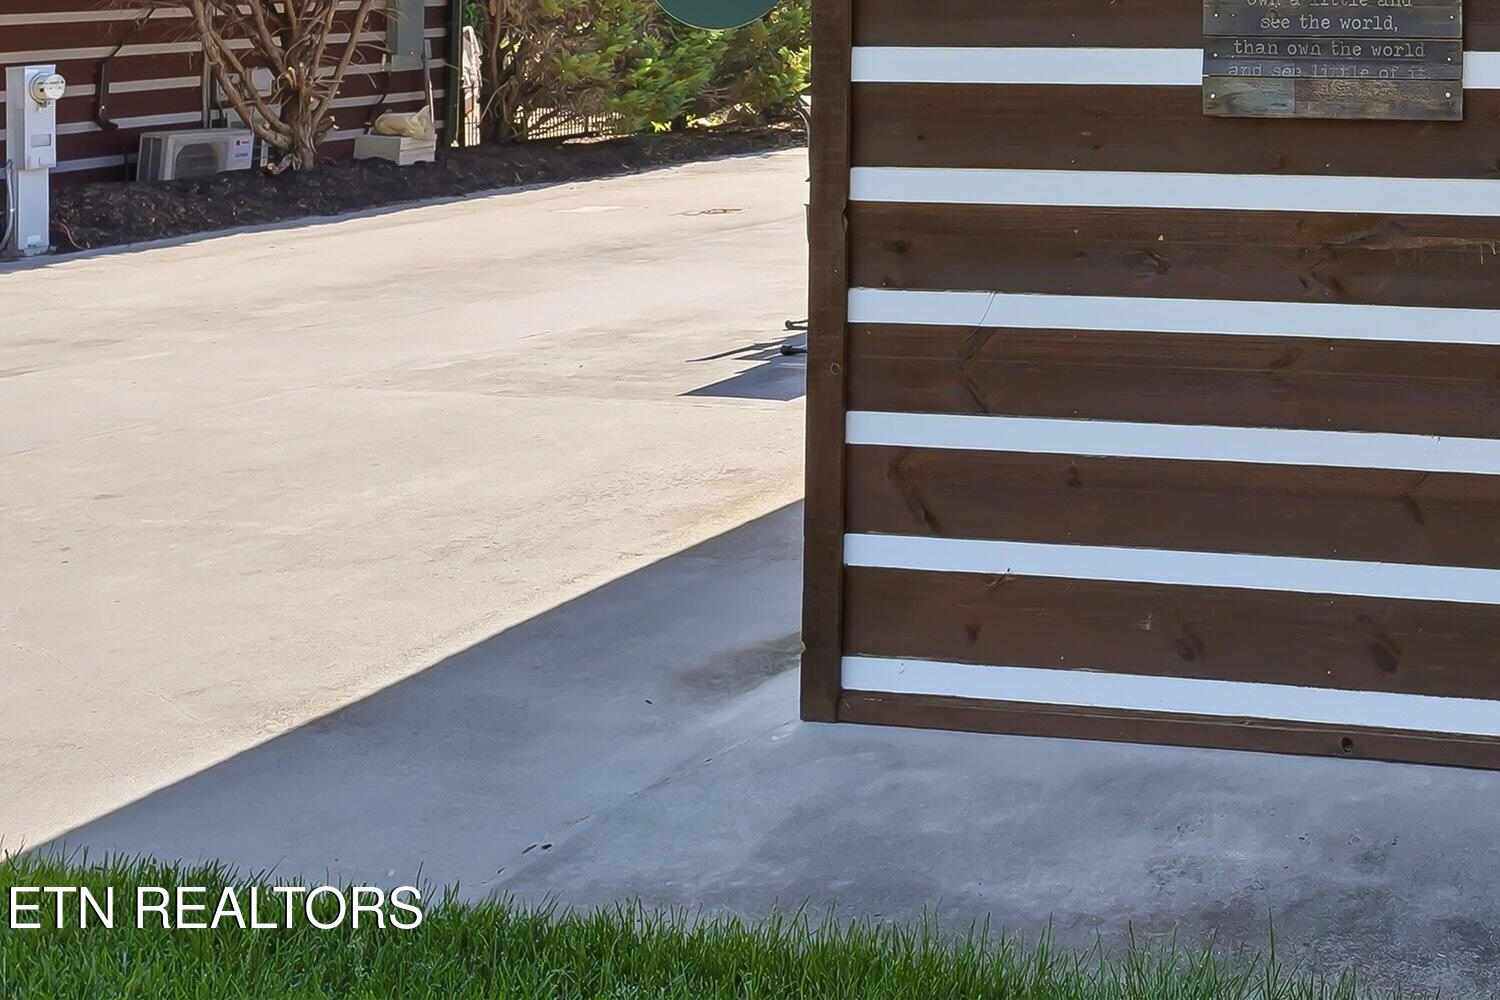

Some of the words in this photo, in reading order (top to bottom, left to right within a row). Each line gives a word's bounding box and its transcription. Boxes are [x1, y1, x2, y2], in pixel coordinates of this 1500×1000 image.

[1260, 16, 1291, 30] see
[1299, 14, 1331, 30] the
[1339, 14, 1399, 33] world,
[1233, 39, 1279, 55] than
[1286, 43, 1322, 56] own
[1331, 40, 1362, 57] the
[1371, 41, 1426, 58] world
[1228, 64, 1263, 77] and
